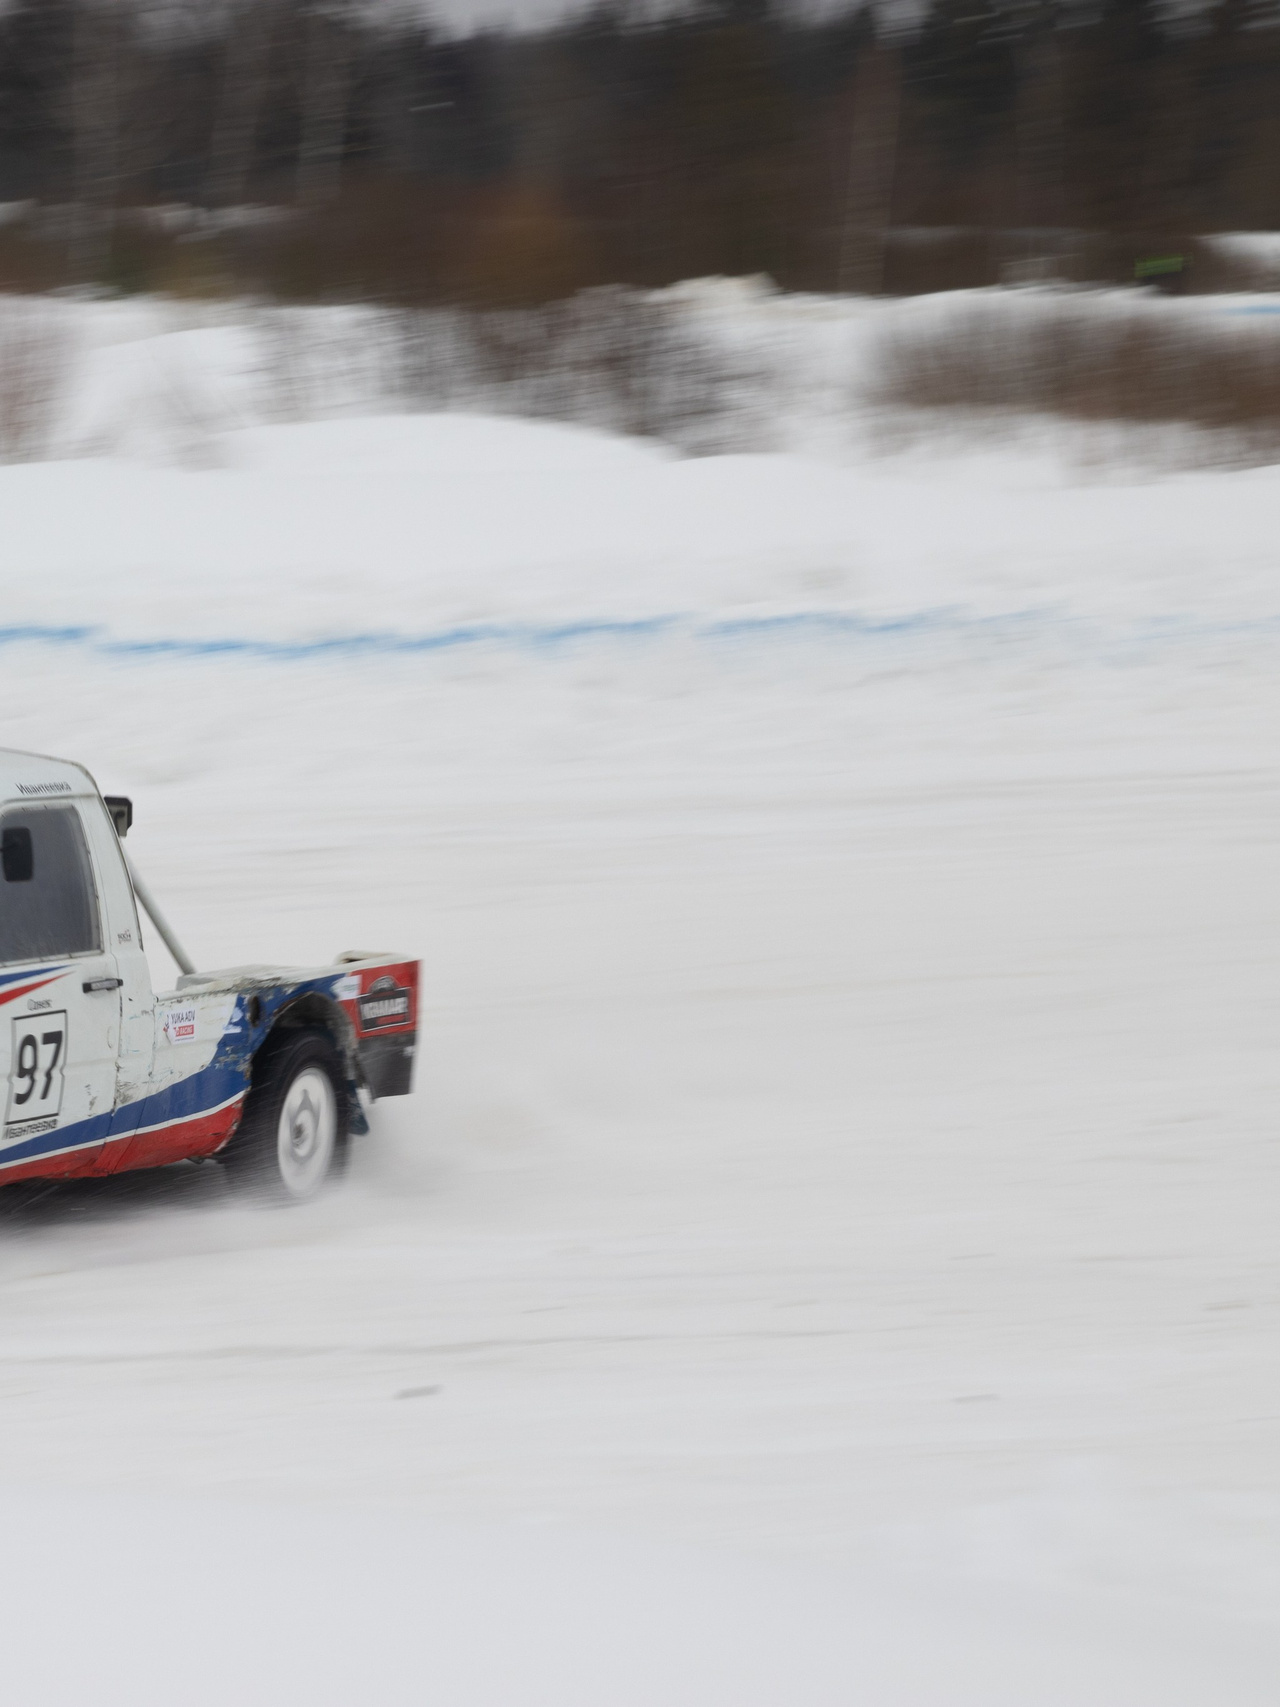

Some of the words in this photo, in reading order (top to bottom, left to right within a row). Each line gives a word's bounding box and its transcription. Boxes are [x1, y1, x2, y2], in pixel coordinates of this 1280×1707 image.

[15, 781, 72, 796] Ивантеевка
[14, 1030, 64, 1106] 97
[2, 1118, 59, 1141] Ивантеевка
